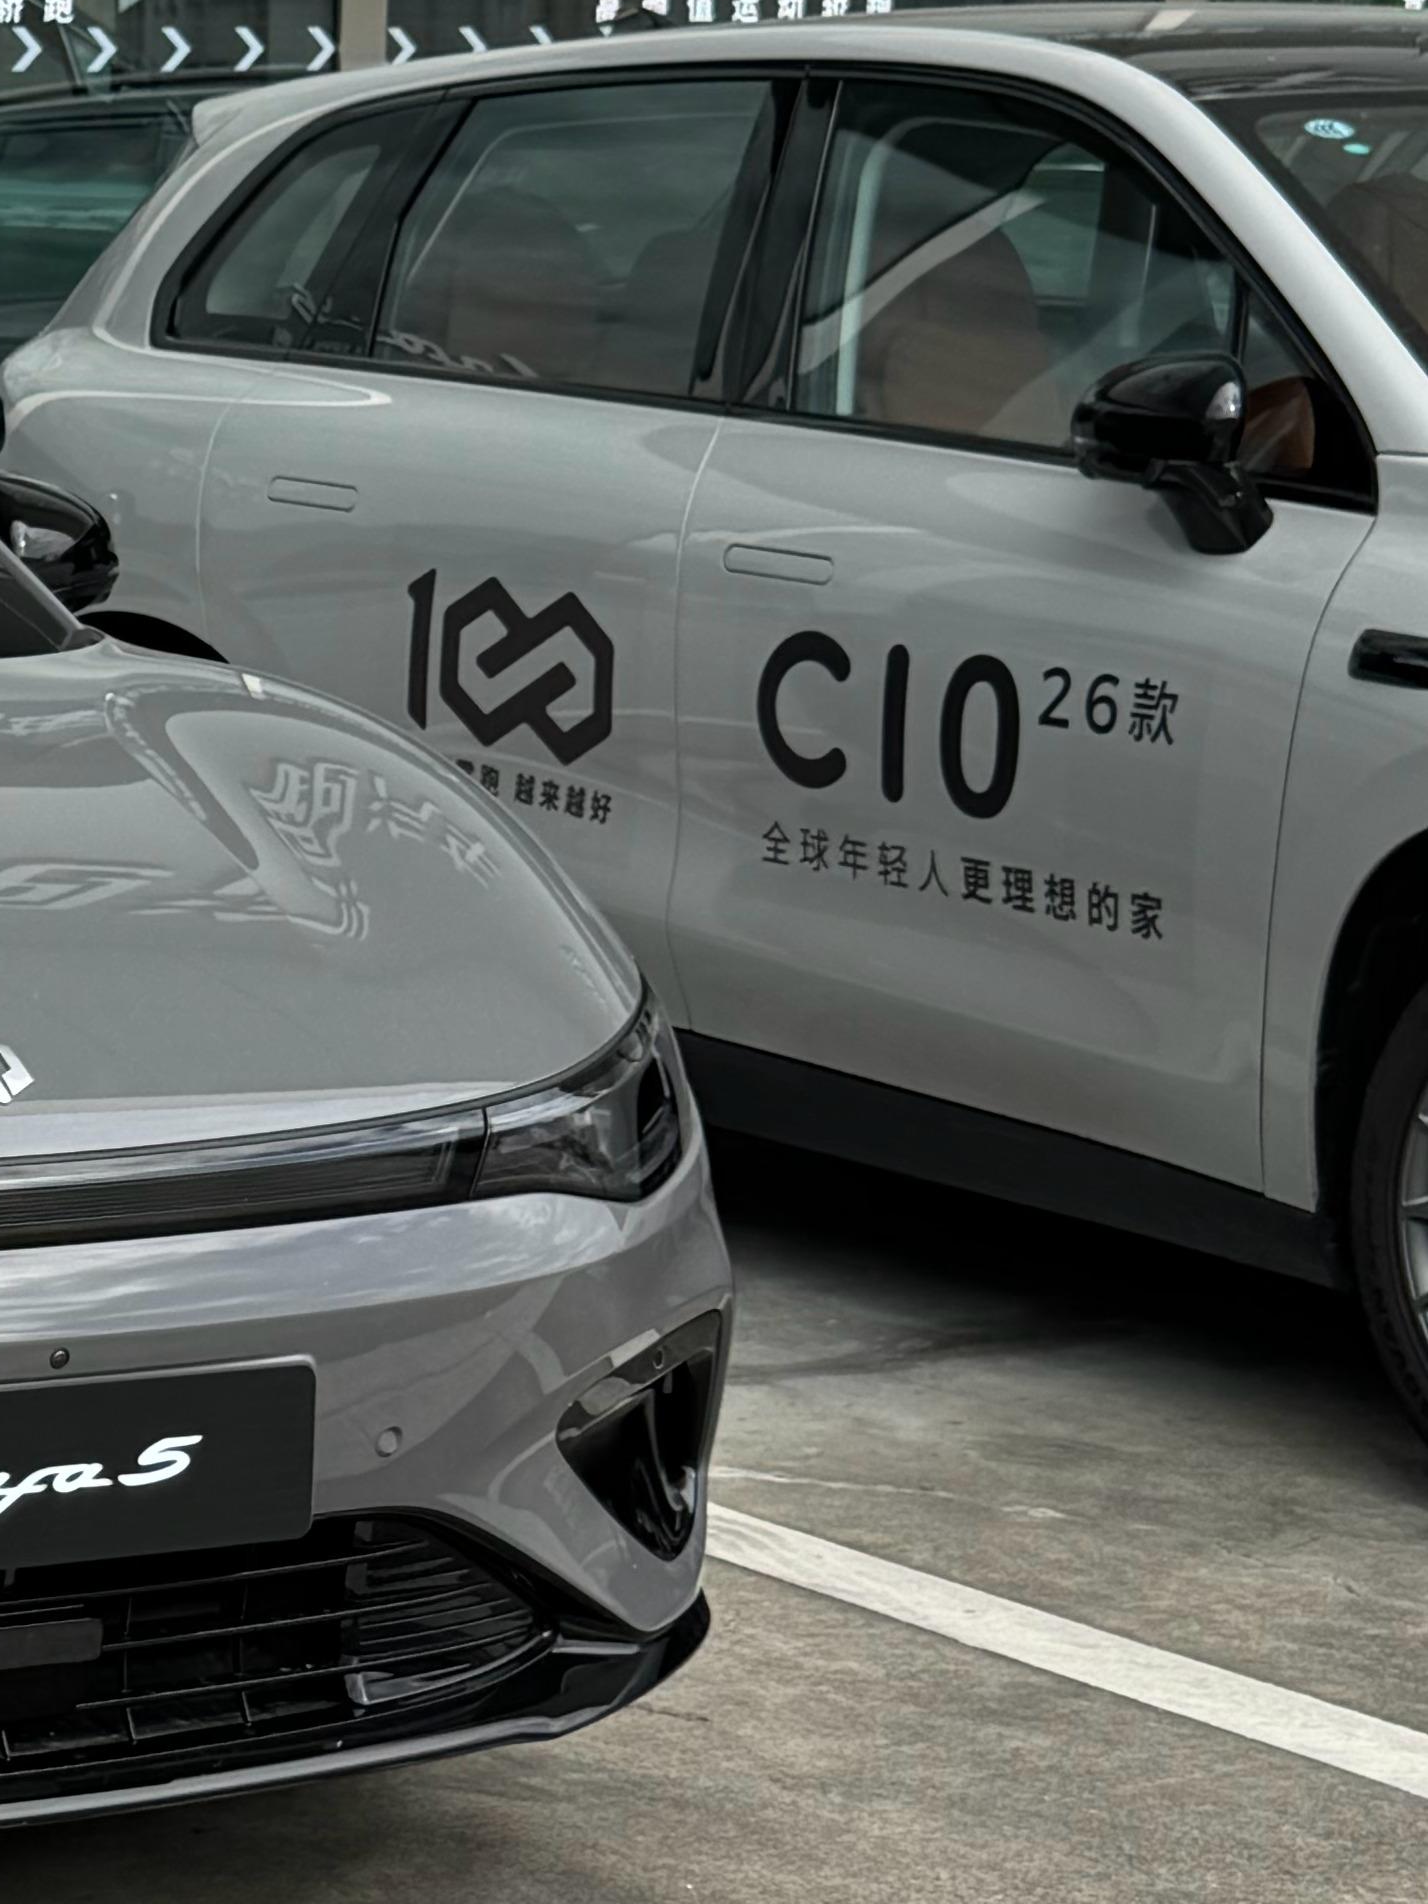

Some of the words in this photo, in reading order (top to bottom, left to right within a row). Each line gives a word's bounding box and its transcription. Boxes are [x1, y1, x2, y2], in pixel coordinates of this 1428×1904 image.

[1038, 667, 1179, 746] 26款
[761, 820, 1164, 941] 全球年轻人更理想的家
